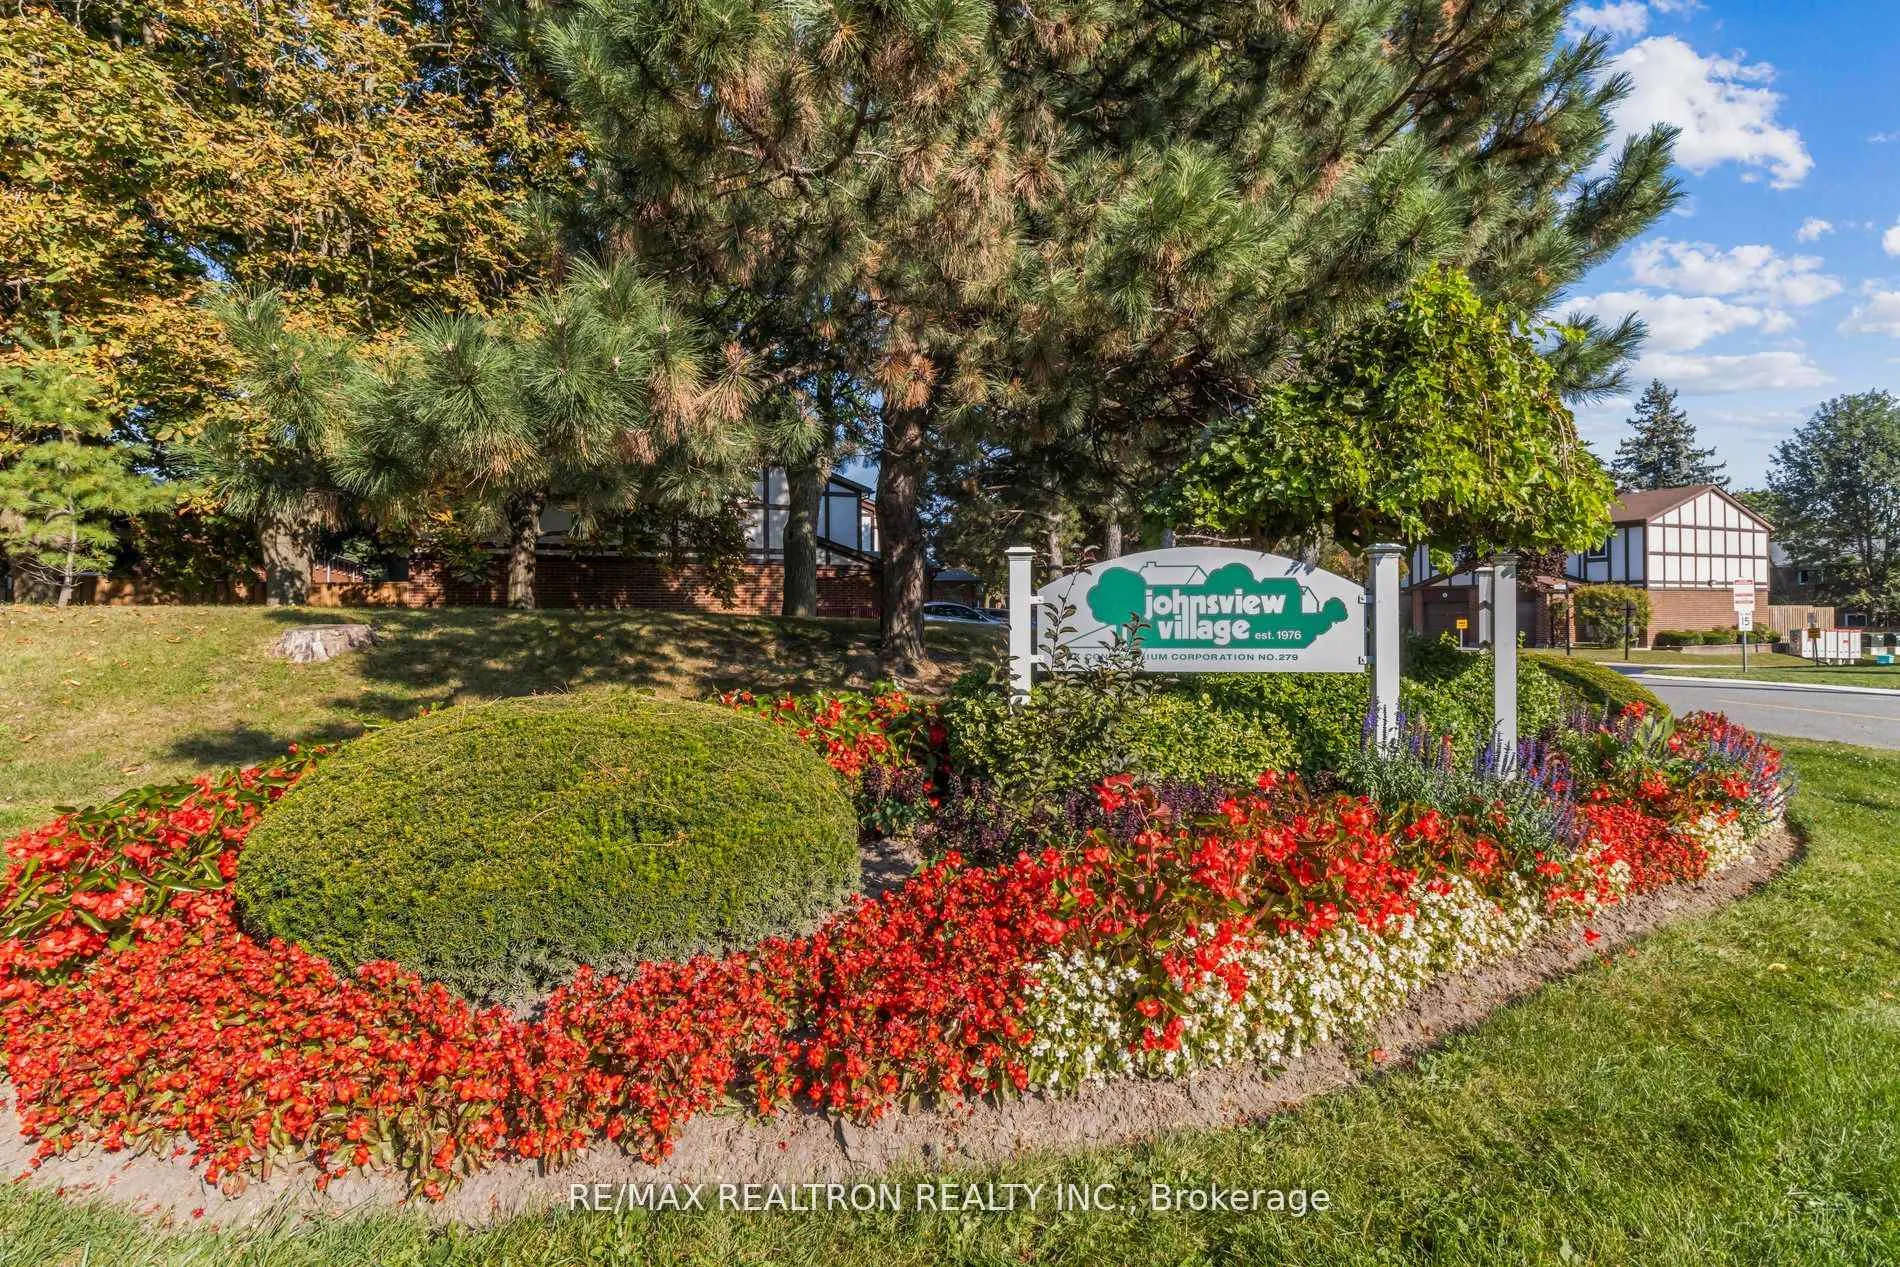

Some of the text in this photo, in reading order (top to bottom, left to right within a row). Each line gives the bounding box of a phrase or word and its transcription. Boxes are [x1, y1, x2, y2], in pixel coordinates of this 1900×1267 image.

[1144, 588, 1287, 620] johnsview
[1741, 615, 1751, 626] 15
[1157, 614, 1250, 646] village
[1254, 630, 1303, 641] est. 1976
[1171, 652, 1255, 661] CORPORATION
